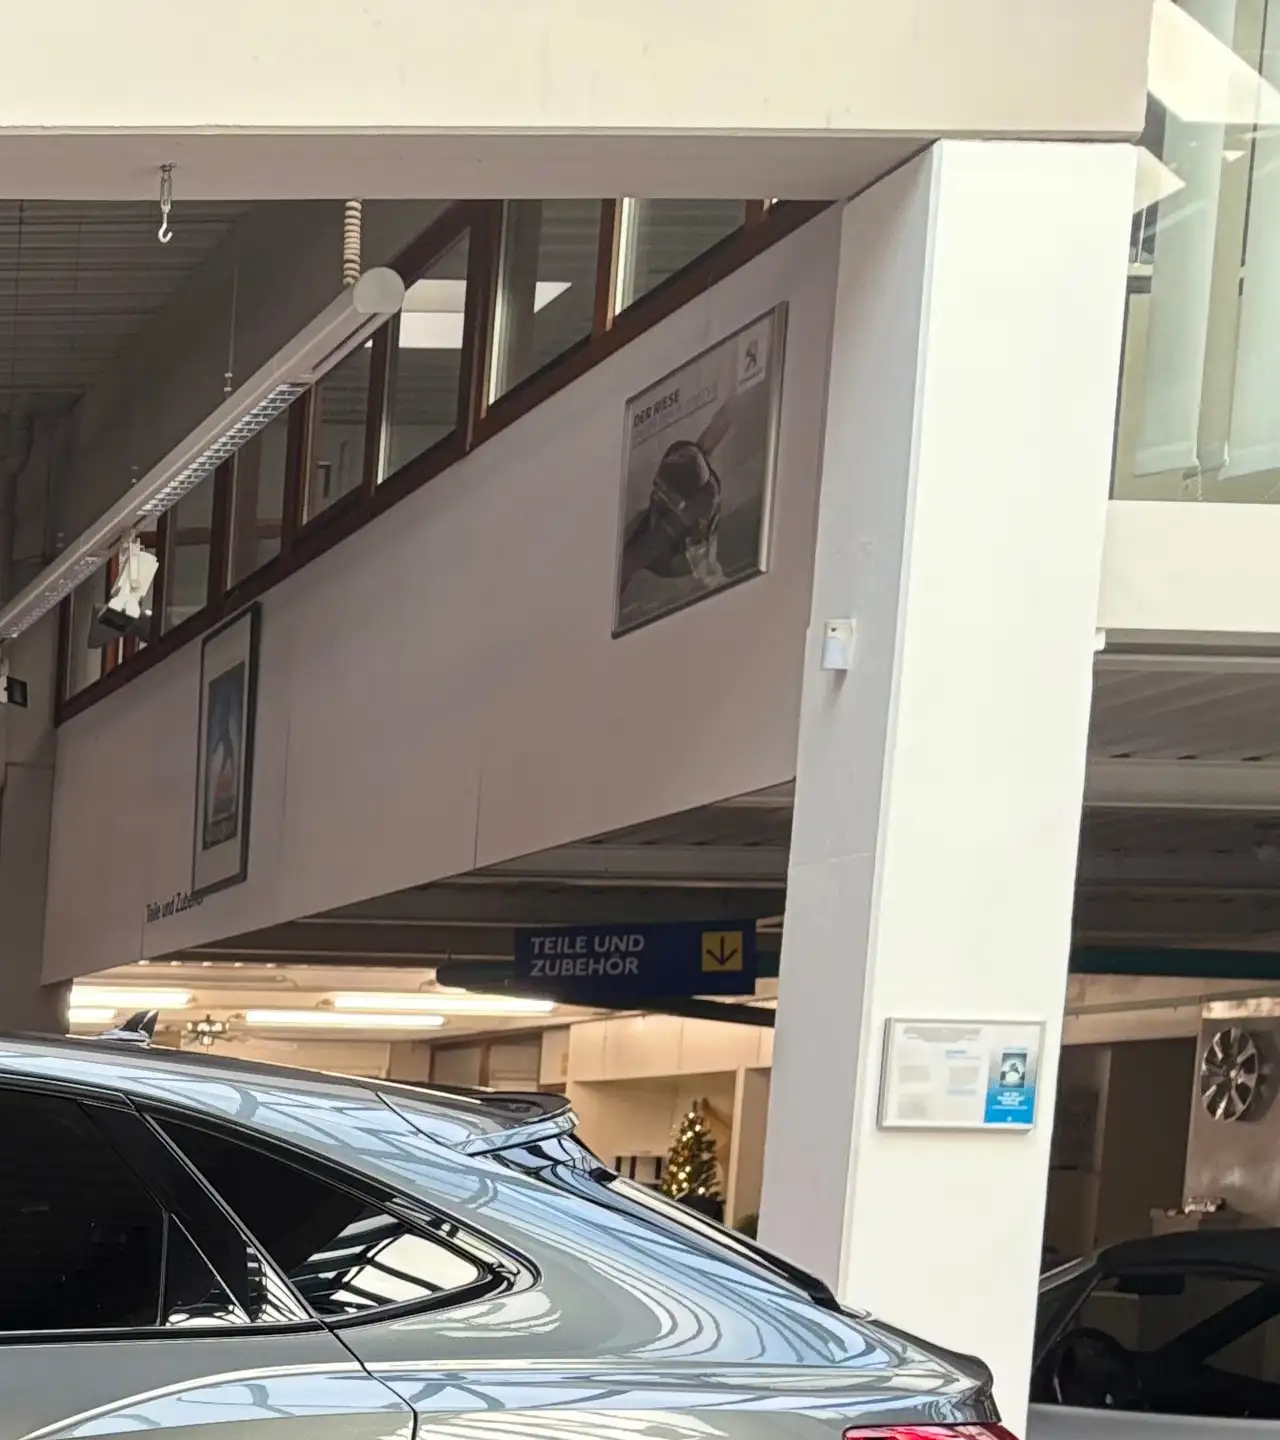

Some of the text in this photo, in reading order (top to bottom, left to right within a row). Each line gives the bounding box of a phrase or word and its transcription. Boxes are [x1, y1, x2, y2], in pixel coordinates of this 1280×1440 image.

[531, 934, 645, 954] TEILE UND
[530, 953, 639, 977] ZUBEHÖR
